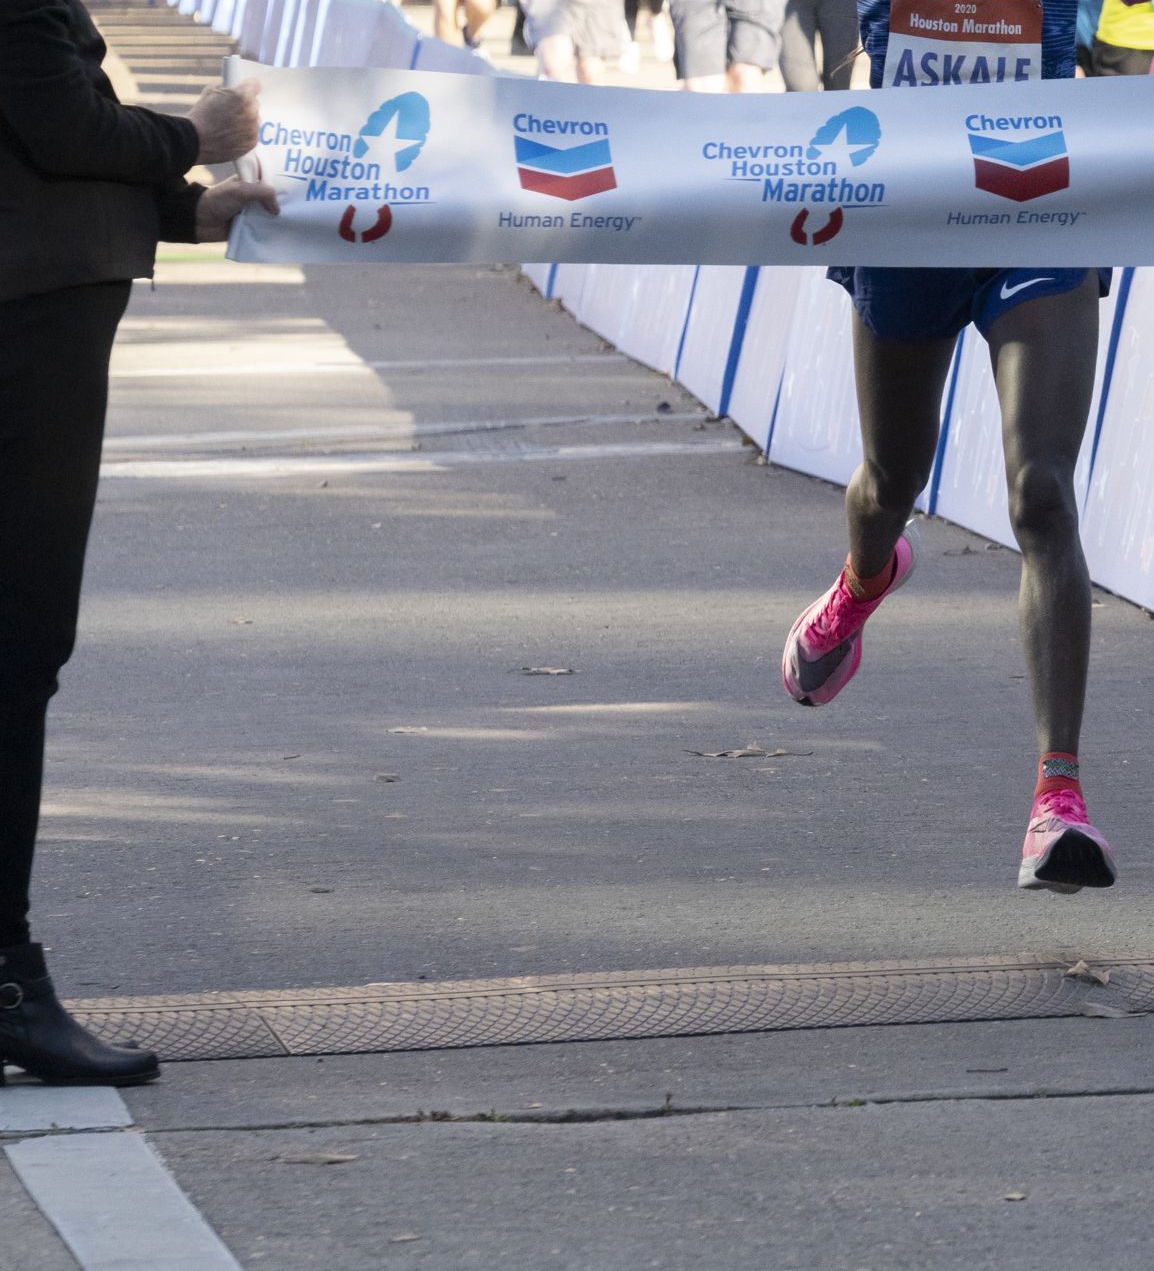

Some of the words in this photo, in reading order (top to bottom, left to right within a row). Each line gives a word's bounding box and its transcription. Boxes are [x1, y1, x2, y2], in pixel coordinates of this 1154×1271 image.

[954, 3, 977, 14] 2020
[910, 13, 958, 33] Houston
[962, 18, 1022, 35] Marathon
[513, 113, 609, 136] Chevron
[965, 114, 1063, 132] Chevron
[258, 121, 352, 152] Chevron
[702, 142, 803, 160] Chevron
[284, 148, 380, 181] Houston
[731, 159, 837, 177] Houston
[305, 179, 430, 202] Marathon
[761, 178, 886, 203] Marathon
[498, 211, 564, 228] Human
[947, 211, 1011, 226] Human
